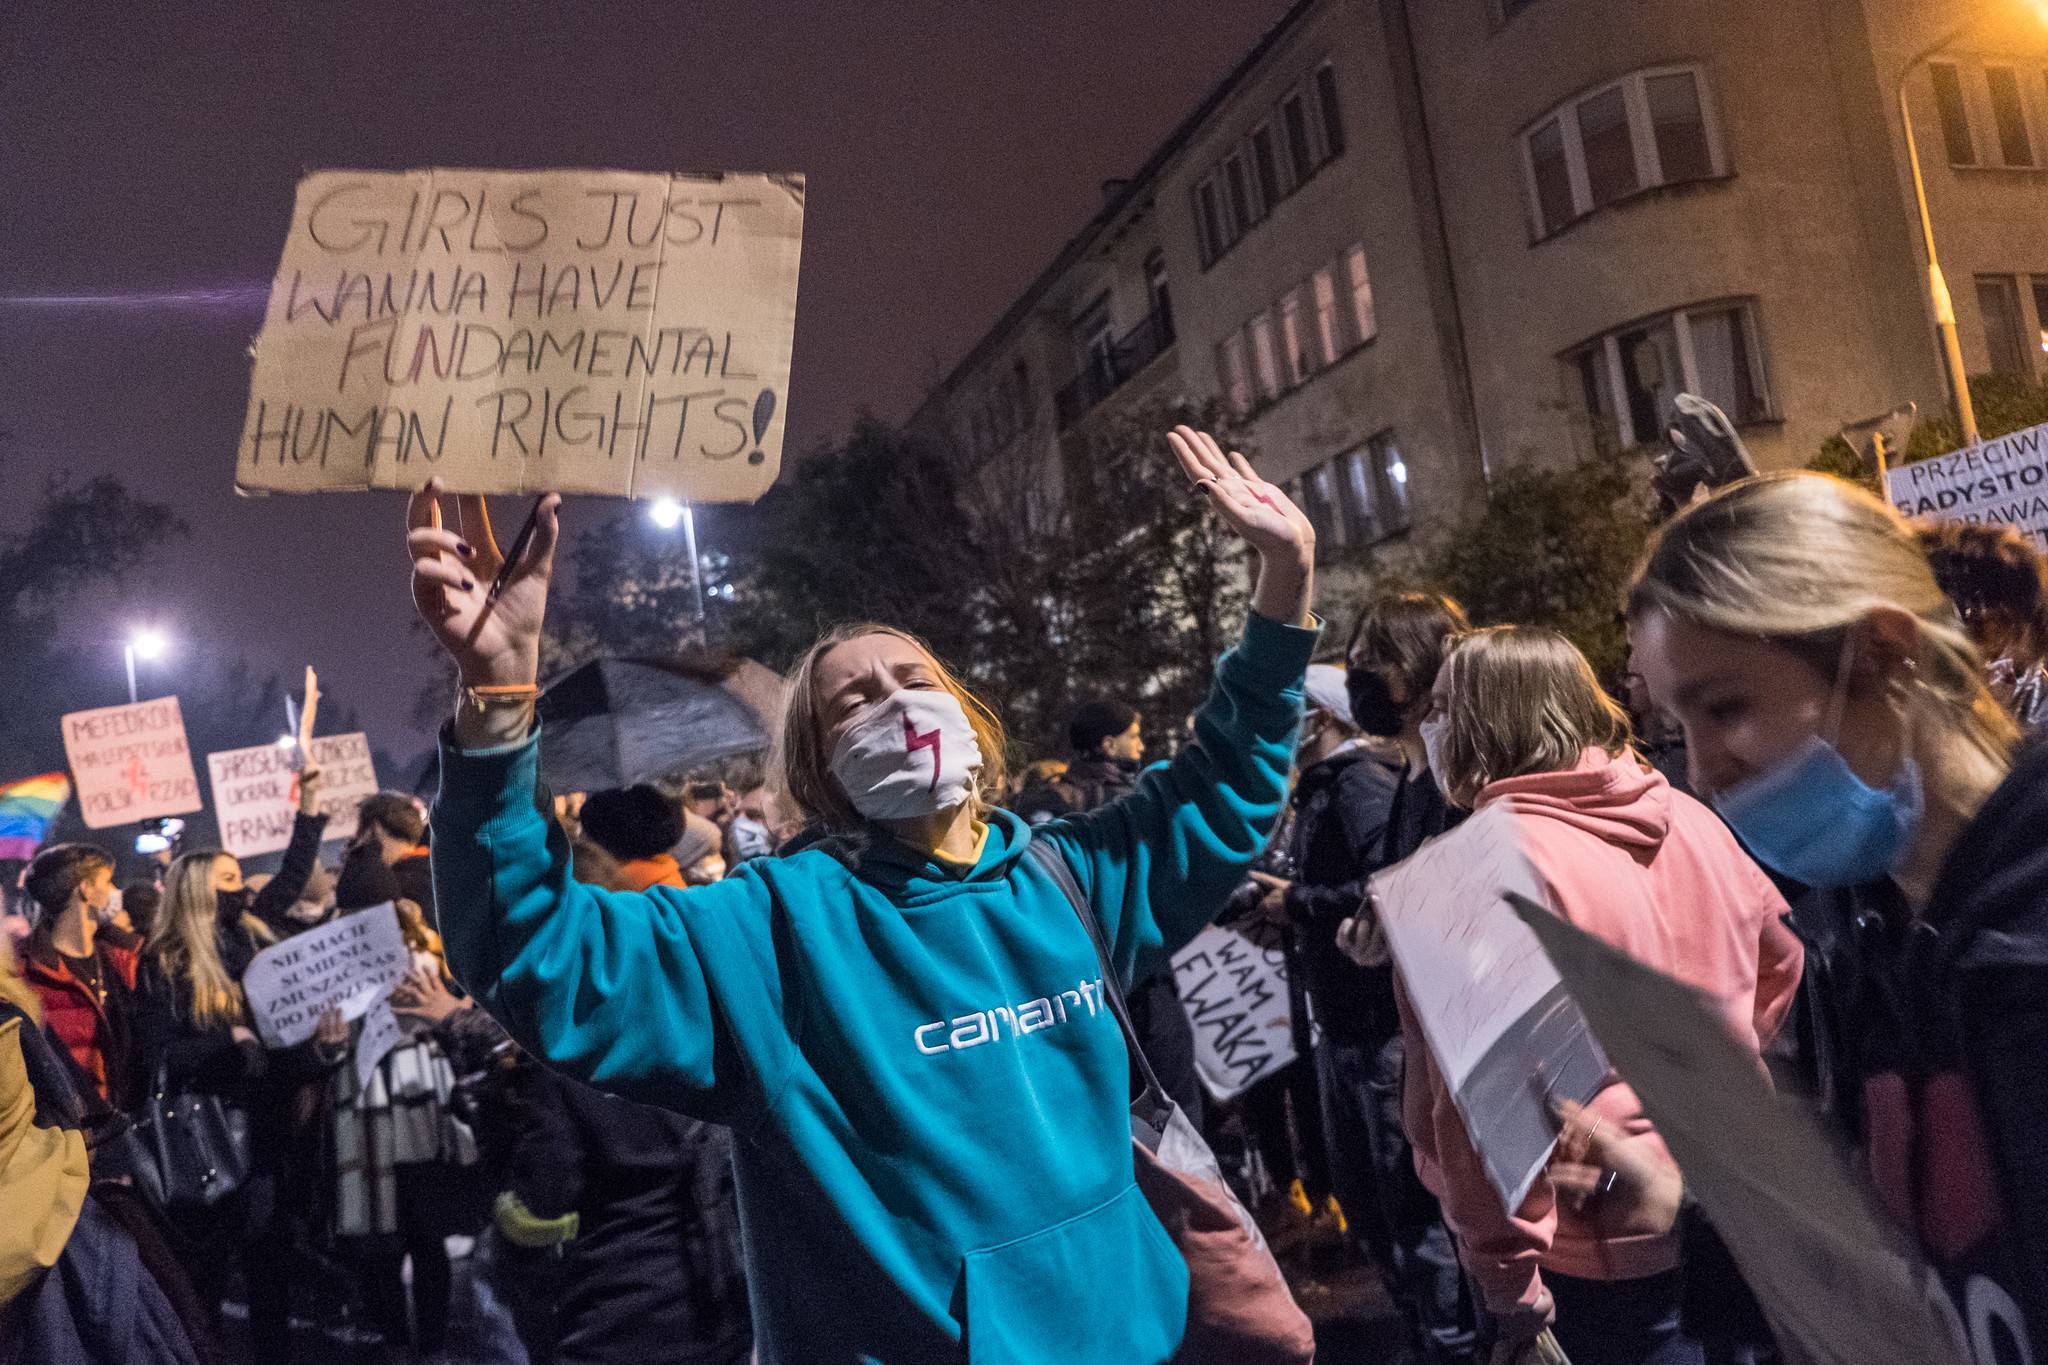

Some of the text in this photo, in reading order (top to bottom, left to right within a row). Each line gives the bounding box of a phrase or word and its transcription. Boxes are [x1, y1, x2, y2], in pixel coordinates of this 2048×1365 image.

[308, 182, 761, 255] GIRLS JUST
[286, 258, 667, 326] WANNA HAVE
[338, 317, 758, 393] FUNDAMENTAL
[248, 386, 778, 469] HUMAN RIGHTS!
[1910, 429, 2039, 486] PRZECIW
[1896, 462, 2048, 518] SADYSTO
[1216, 938, 1275, 1012] WAM
